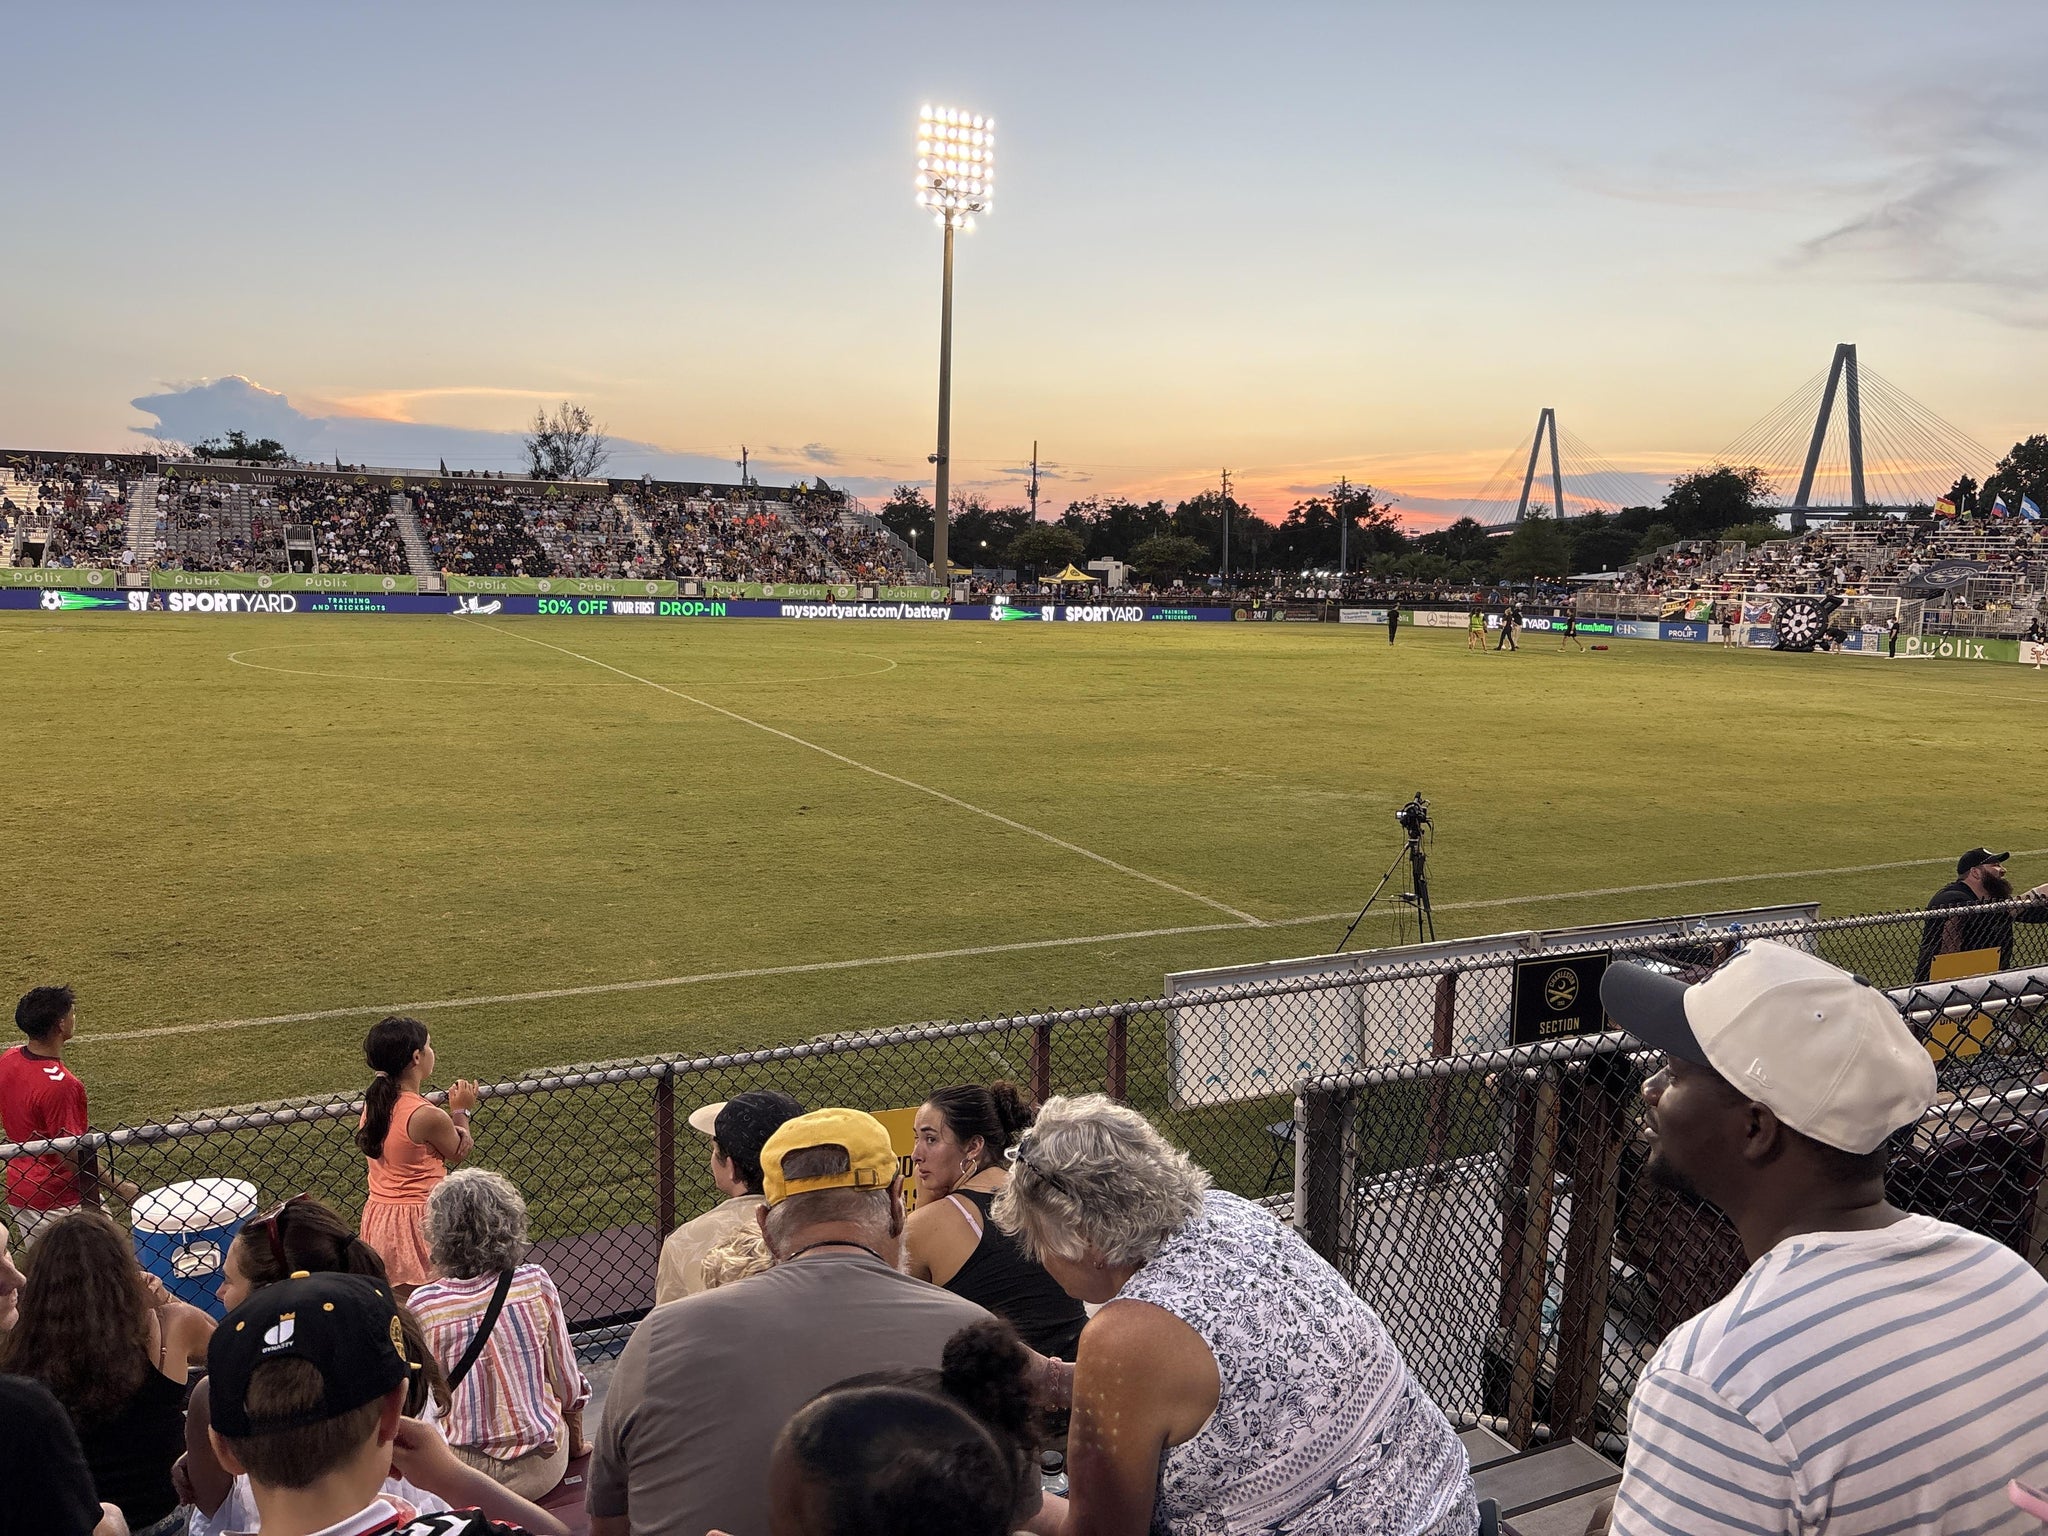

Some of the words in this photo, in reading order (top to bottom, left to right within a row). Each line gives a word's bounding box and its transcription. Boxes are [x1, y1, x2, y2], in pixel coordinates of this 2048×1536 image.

[13, 572, 62, 583] Publix
[175, 575, 221, 586] Publix
[305, 578, 348, 588] Publix
[468, 580, 507, 590] Publix
[578, 583, 616, 592] Publix
[788, 587, 821, 596] Publix
[887, 589, 918, 599] Publix
[128, 591, 149, 611] SY
[169, 592, 296, 612] SPORTYARD
[538, 600, 573, 615] 50%
[578, 600, 608, 615] OFF
[613, 601, 635, 614] YOUR
[635, 601, 655, 614] FIRST
[659, 602, 726, 616] DROP-IN
[781, 603, 951, 620] mysportyard.com/battery
[1041, 606, 1055, 621] SY
[1066, 606, 1143, 622] SPORTYARD
[1906, 637, 1985, 660] Publix
[1539, 1017, 1580, 1035] SECTION
